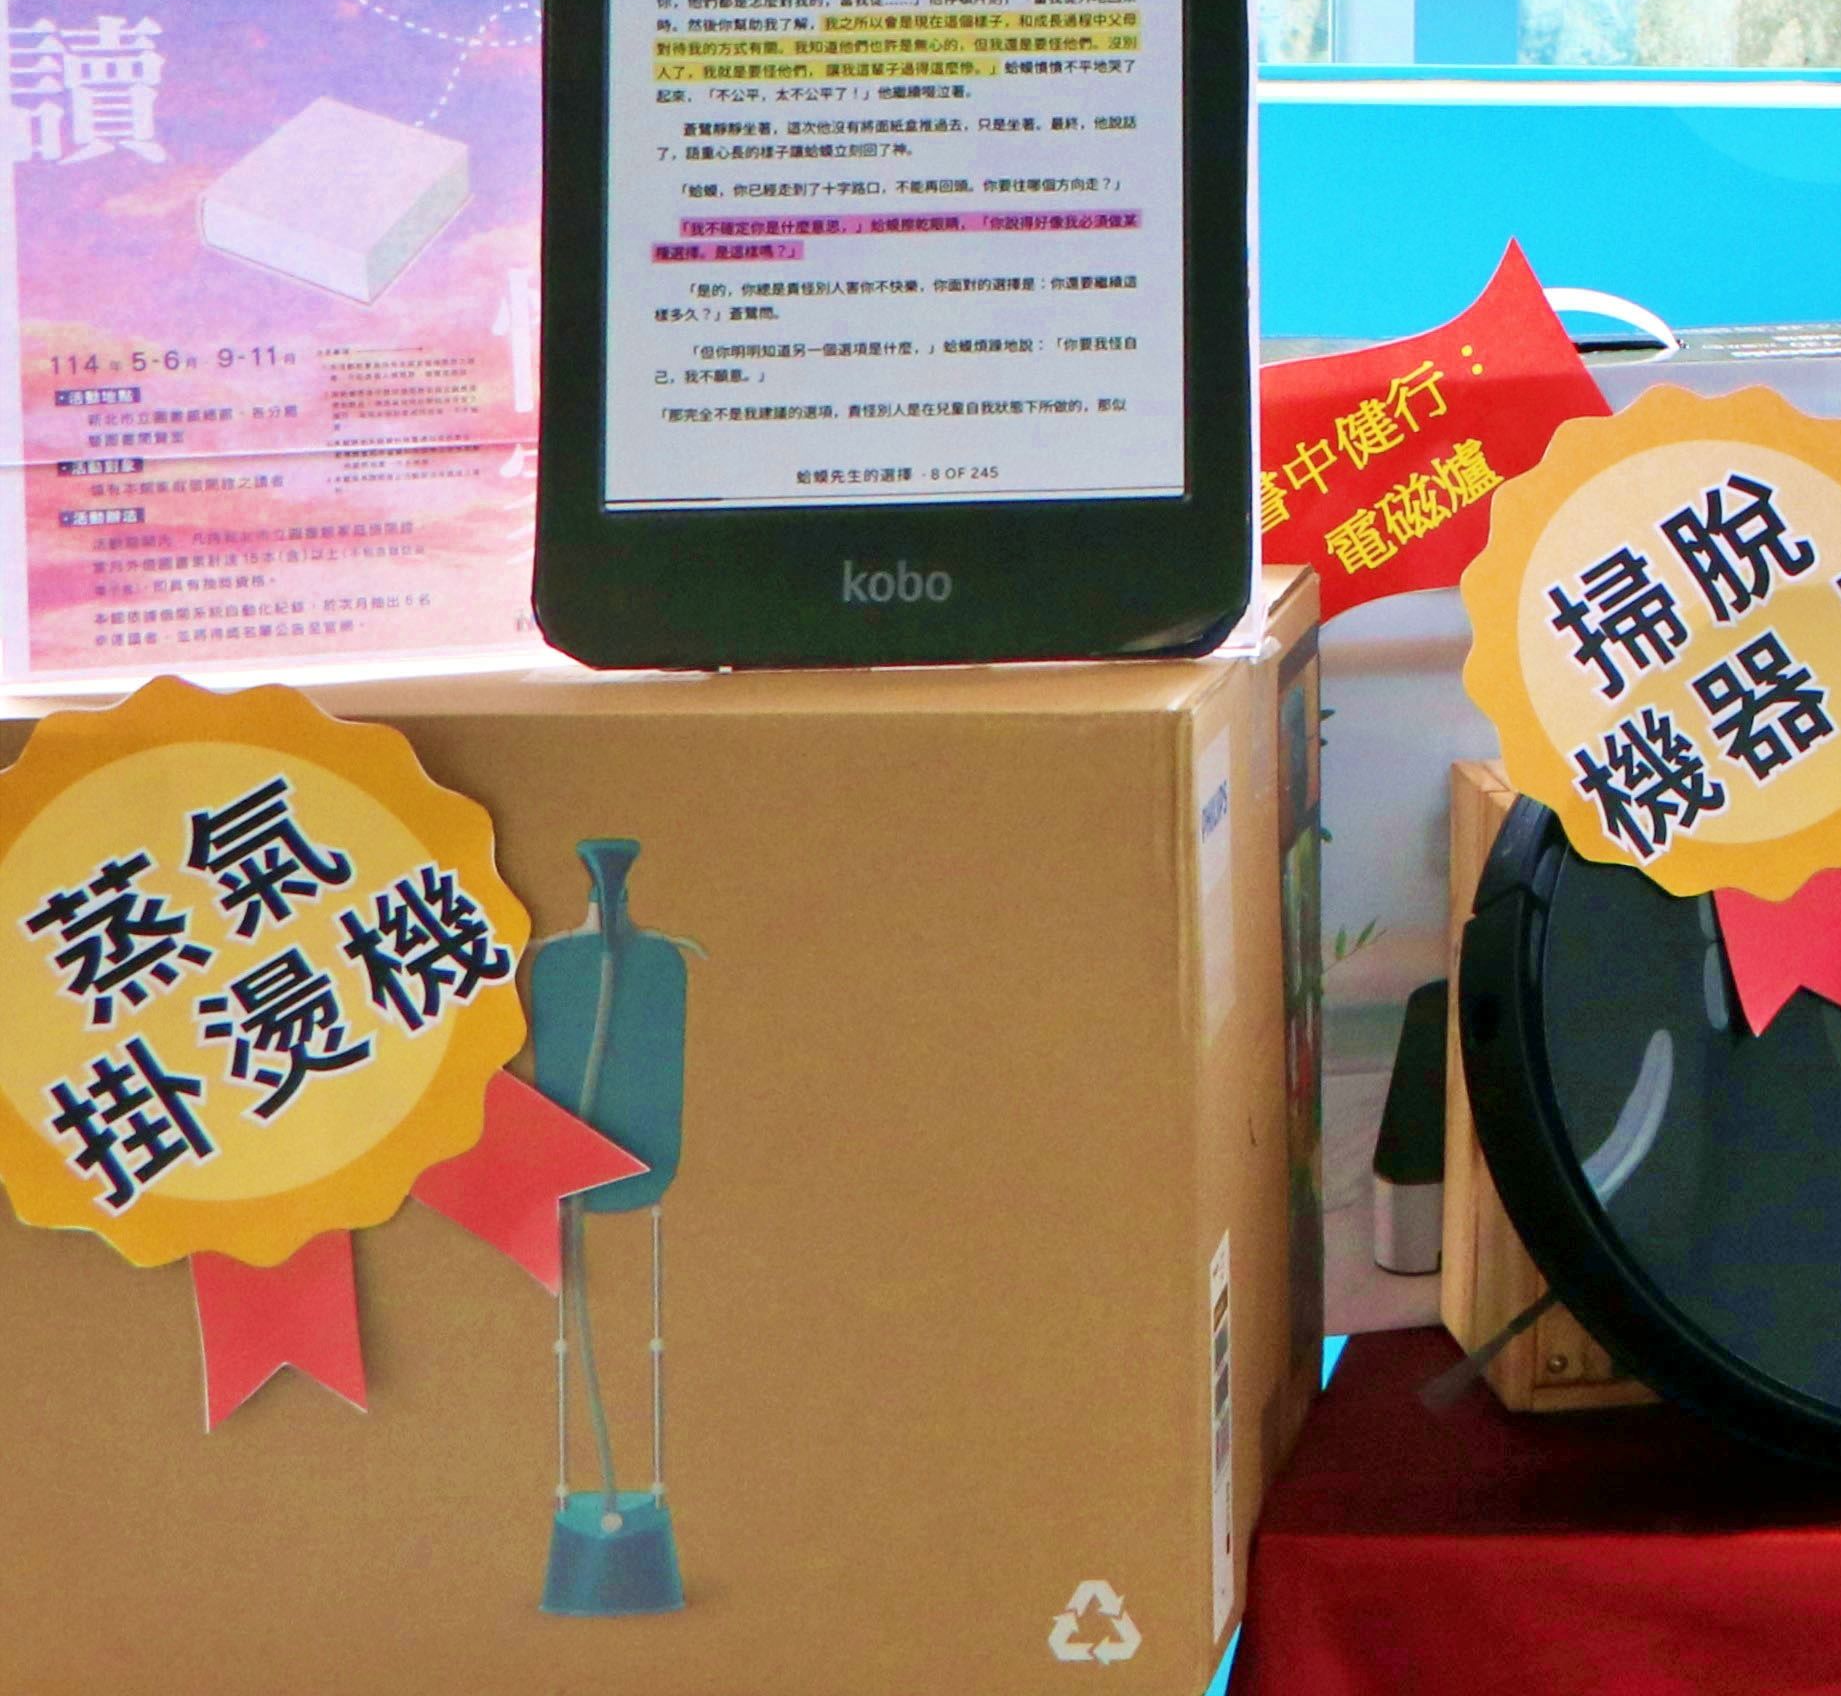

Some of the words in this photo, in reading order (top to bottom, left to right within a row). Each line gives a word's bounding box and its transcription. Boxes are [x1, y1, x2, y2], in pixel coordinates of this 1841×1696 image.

[796, 465, 913, 486] 蛤蟆先生的選擇
[945, 467, 967, 481] OF
[971, 466, 999, 480] 245
[1324, 438, 1505, 575] 電磁爐
[842, 561, 952, 601] kobo
[26, 778, 352, 1027] 蒸氣
[49, 869, 514, 1211] 掛燙機
